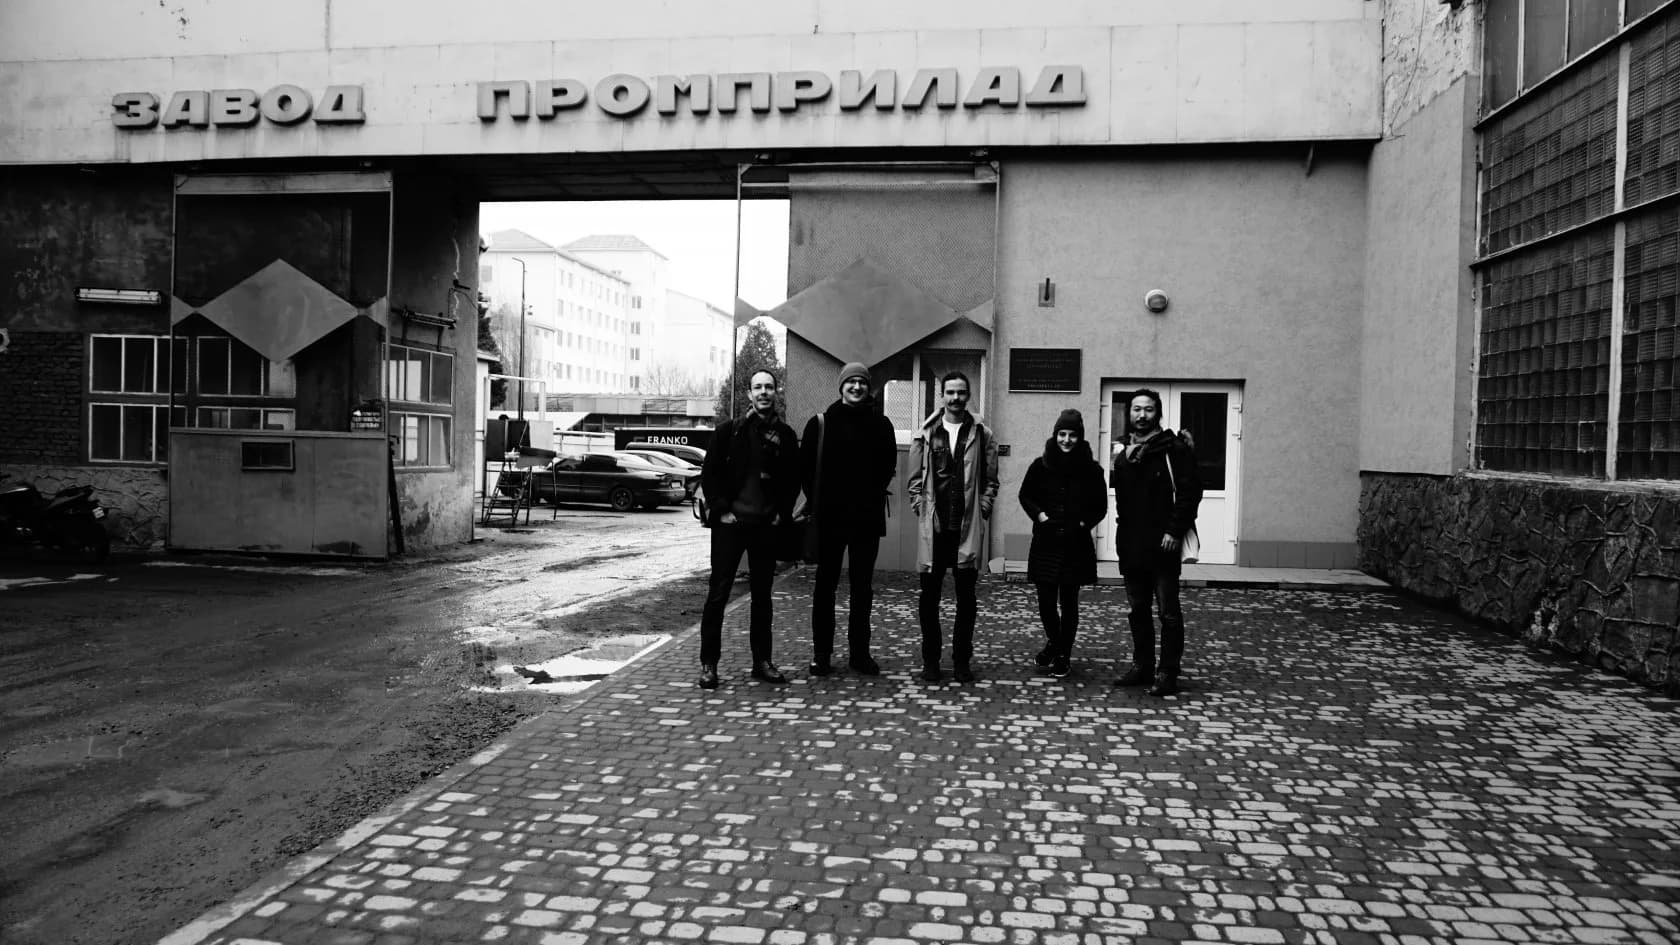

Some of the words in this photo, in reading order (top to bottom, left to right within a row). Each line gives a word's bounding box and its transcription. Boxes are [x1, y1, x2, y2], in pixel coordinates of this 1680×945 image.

[111, 84, 366, 129] ЗАВОД
[476, 65, 1087, 122] ПРОМПРИЛАД
[647, 436, 688, 445] FRANKO
